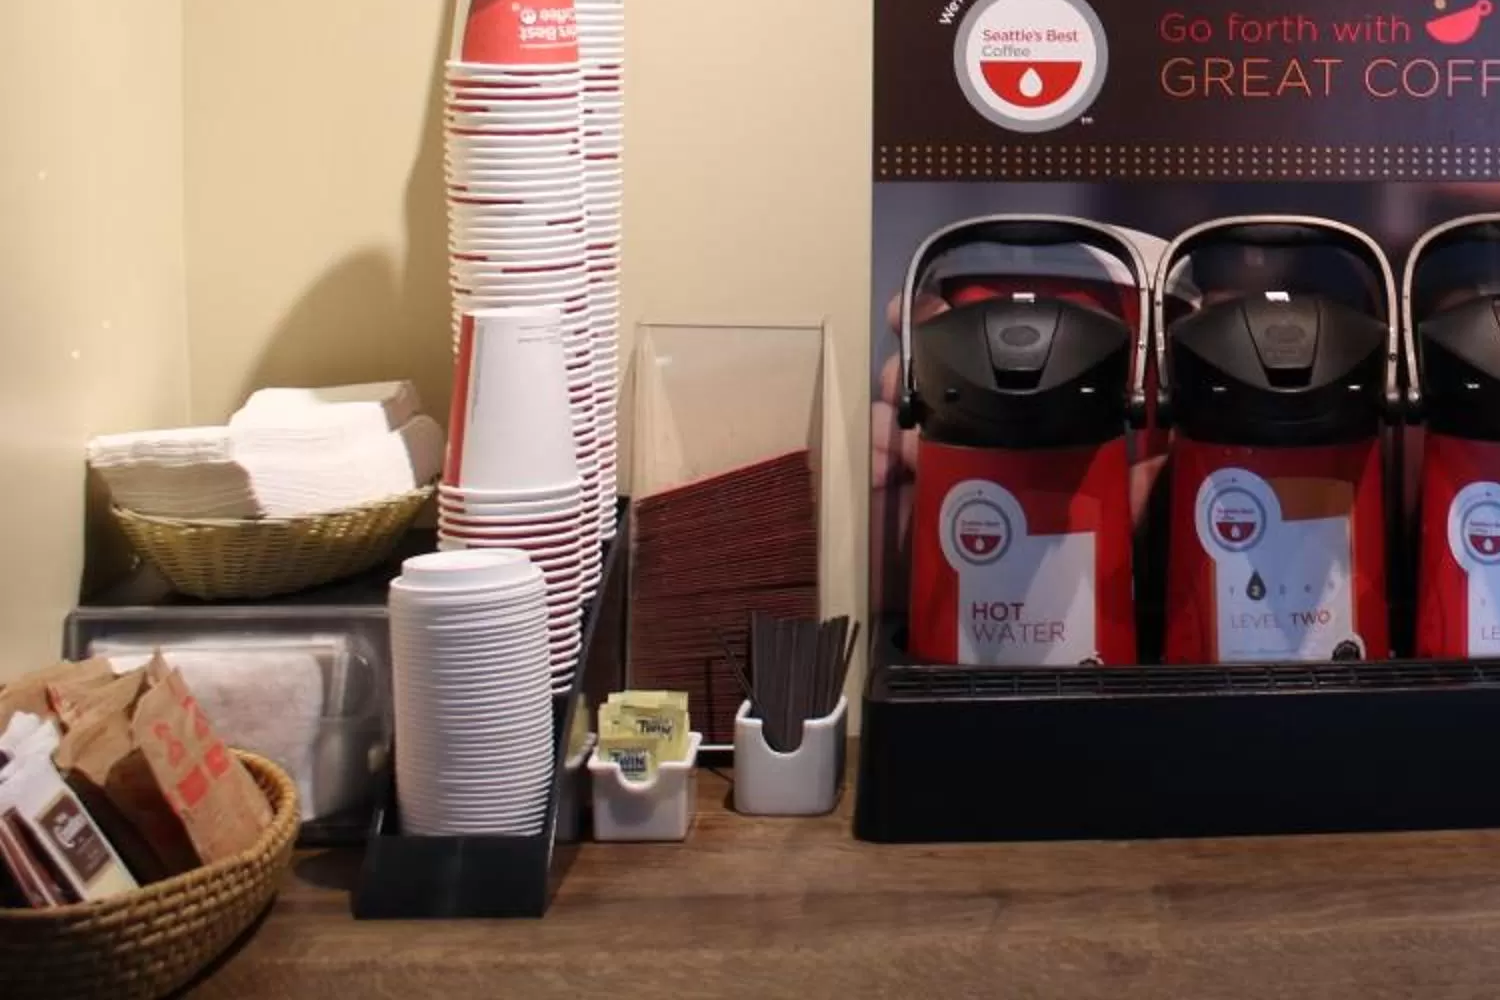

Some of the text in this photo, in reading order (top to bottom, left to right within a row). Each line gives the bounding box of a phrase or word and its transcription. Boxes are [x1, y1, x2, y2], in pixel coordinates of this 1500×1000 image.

[981, 28, 1079, 42] Seattle's Best
[1159, 11, 1412, 44] Go forth with
[981, 44, 1032, 58] Coffee
[1160, 56, 1344, 98] GREAT
[972, 601, 1025, 622] HOT
[1230, 609, 1331, 630] LEVEL TWO
[972, 621, 1066, 645] WATER
